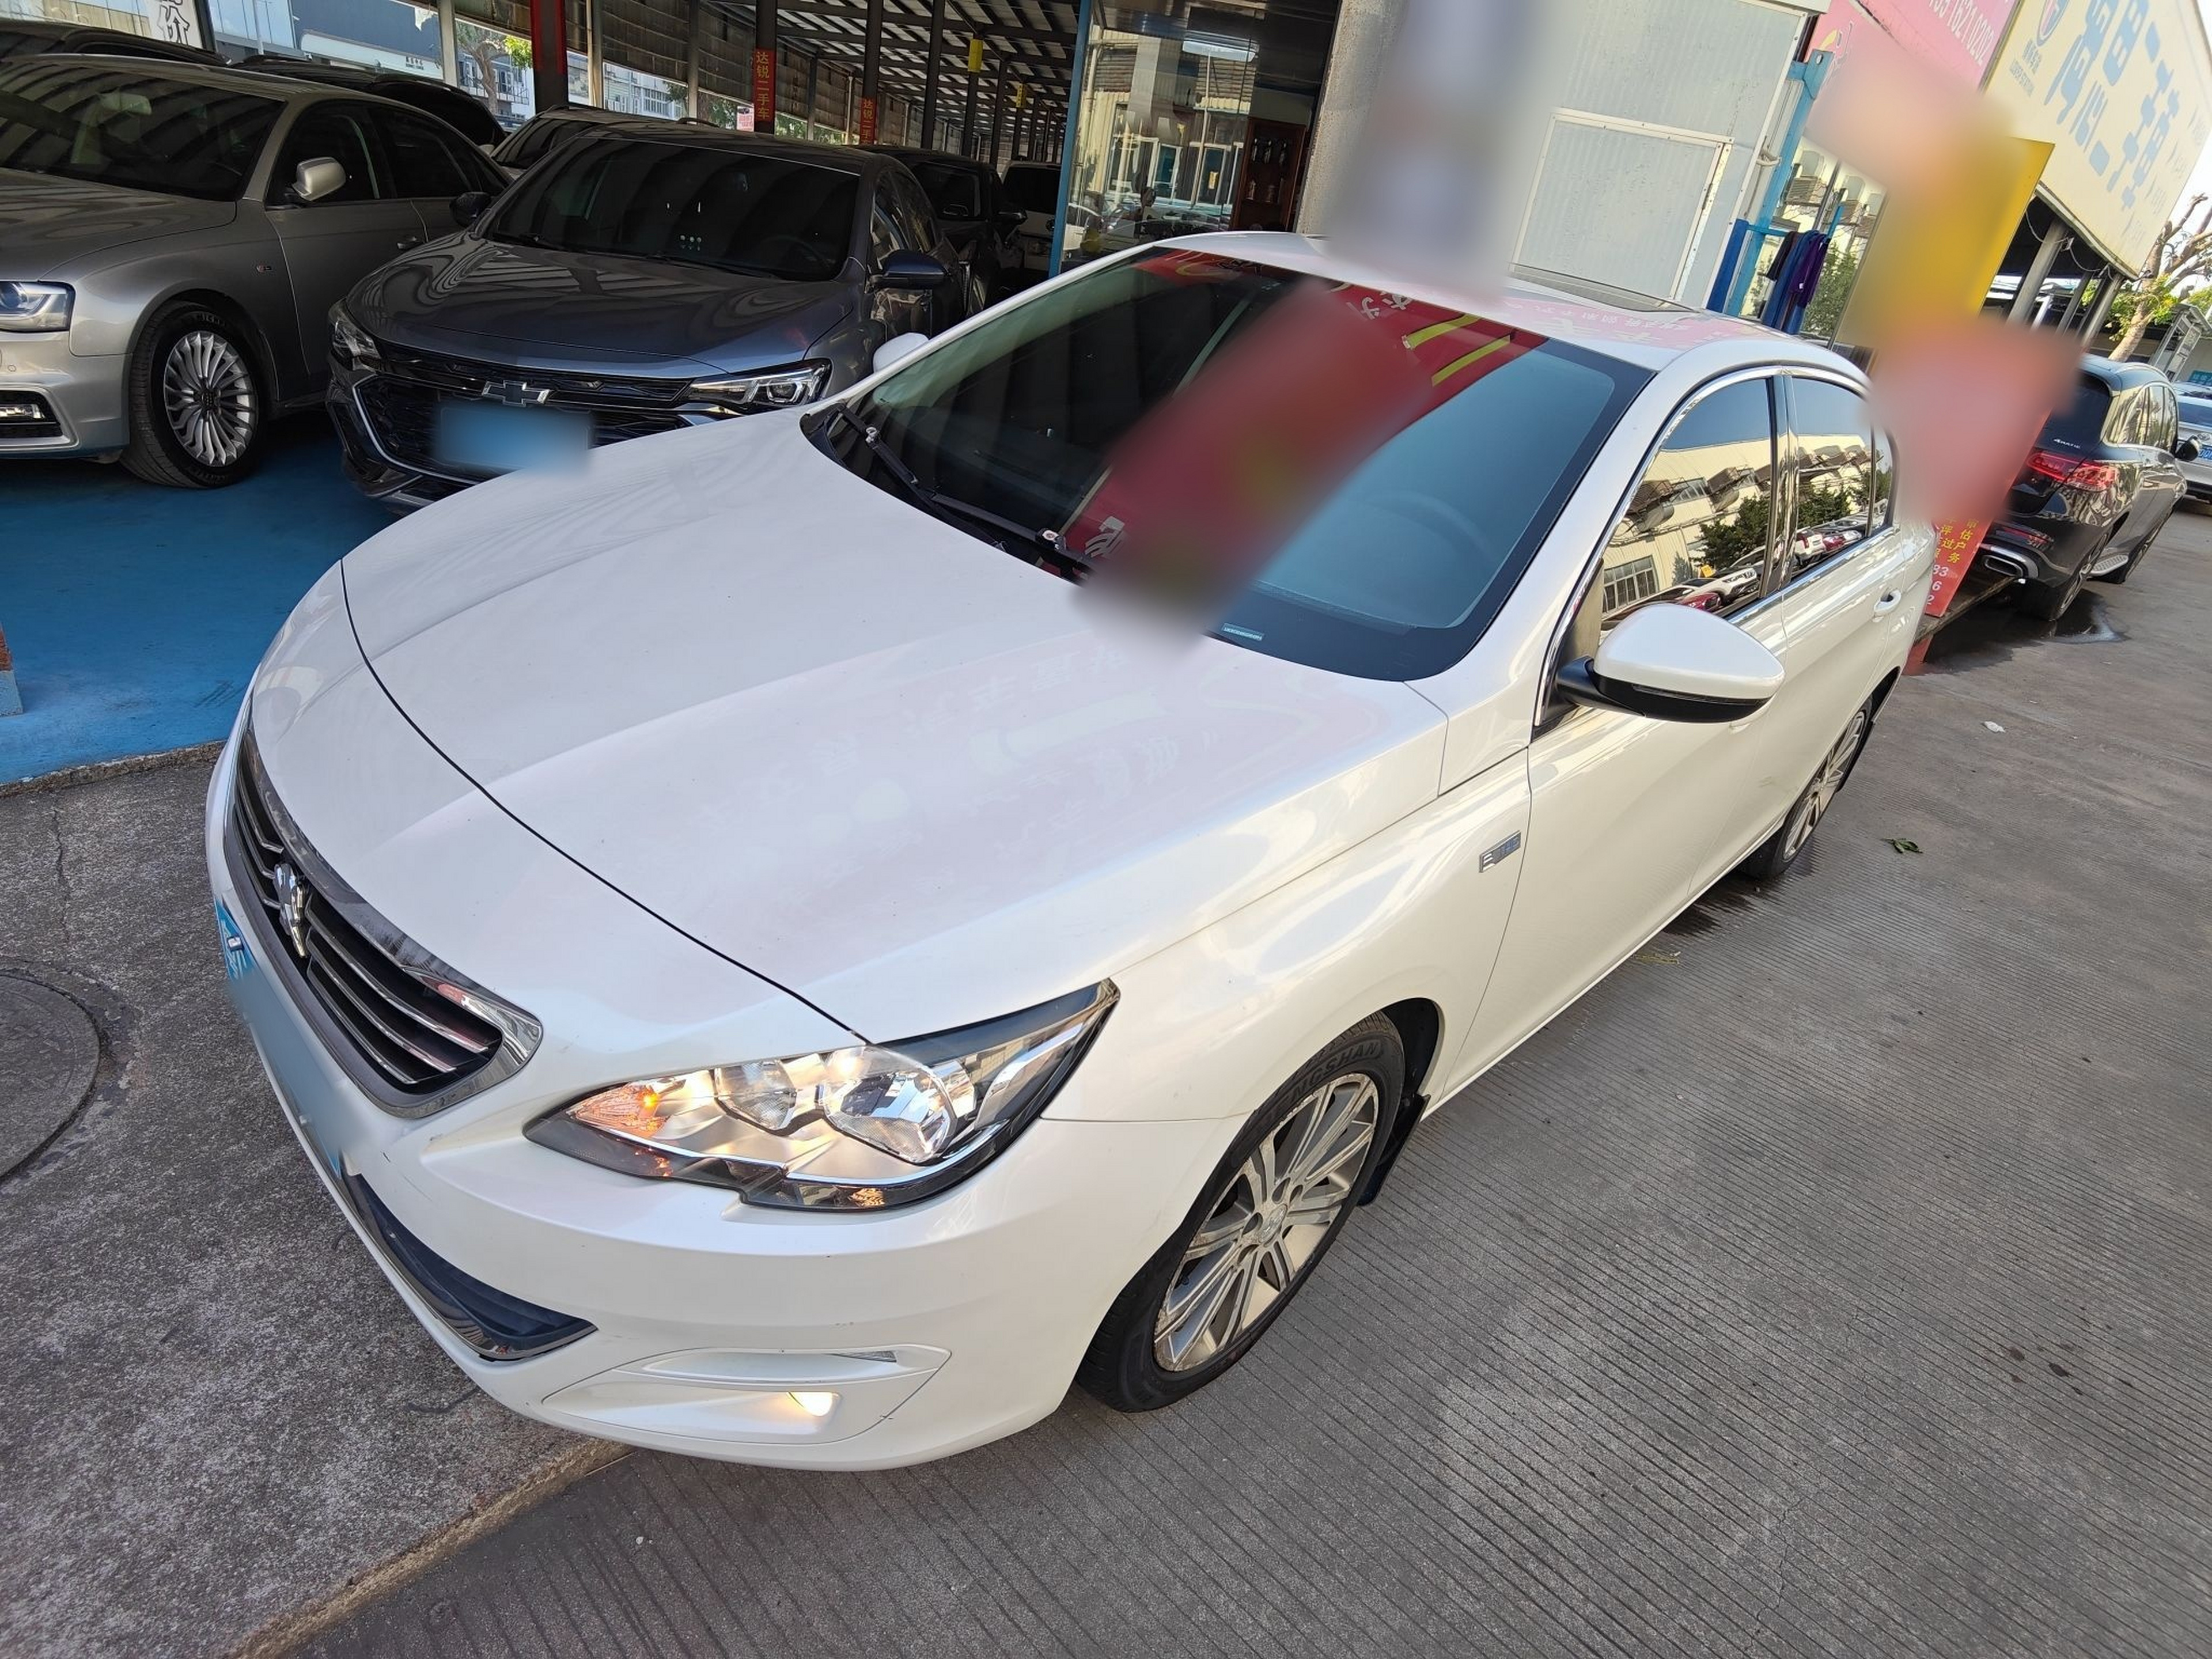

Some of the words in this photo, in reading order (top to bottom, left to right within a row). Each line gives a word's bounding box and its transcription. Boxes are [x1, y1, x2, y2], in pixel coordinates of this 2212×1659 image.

[756, 51, 770, 119] 达锐二手车
